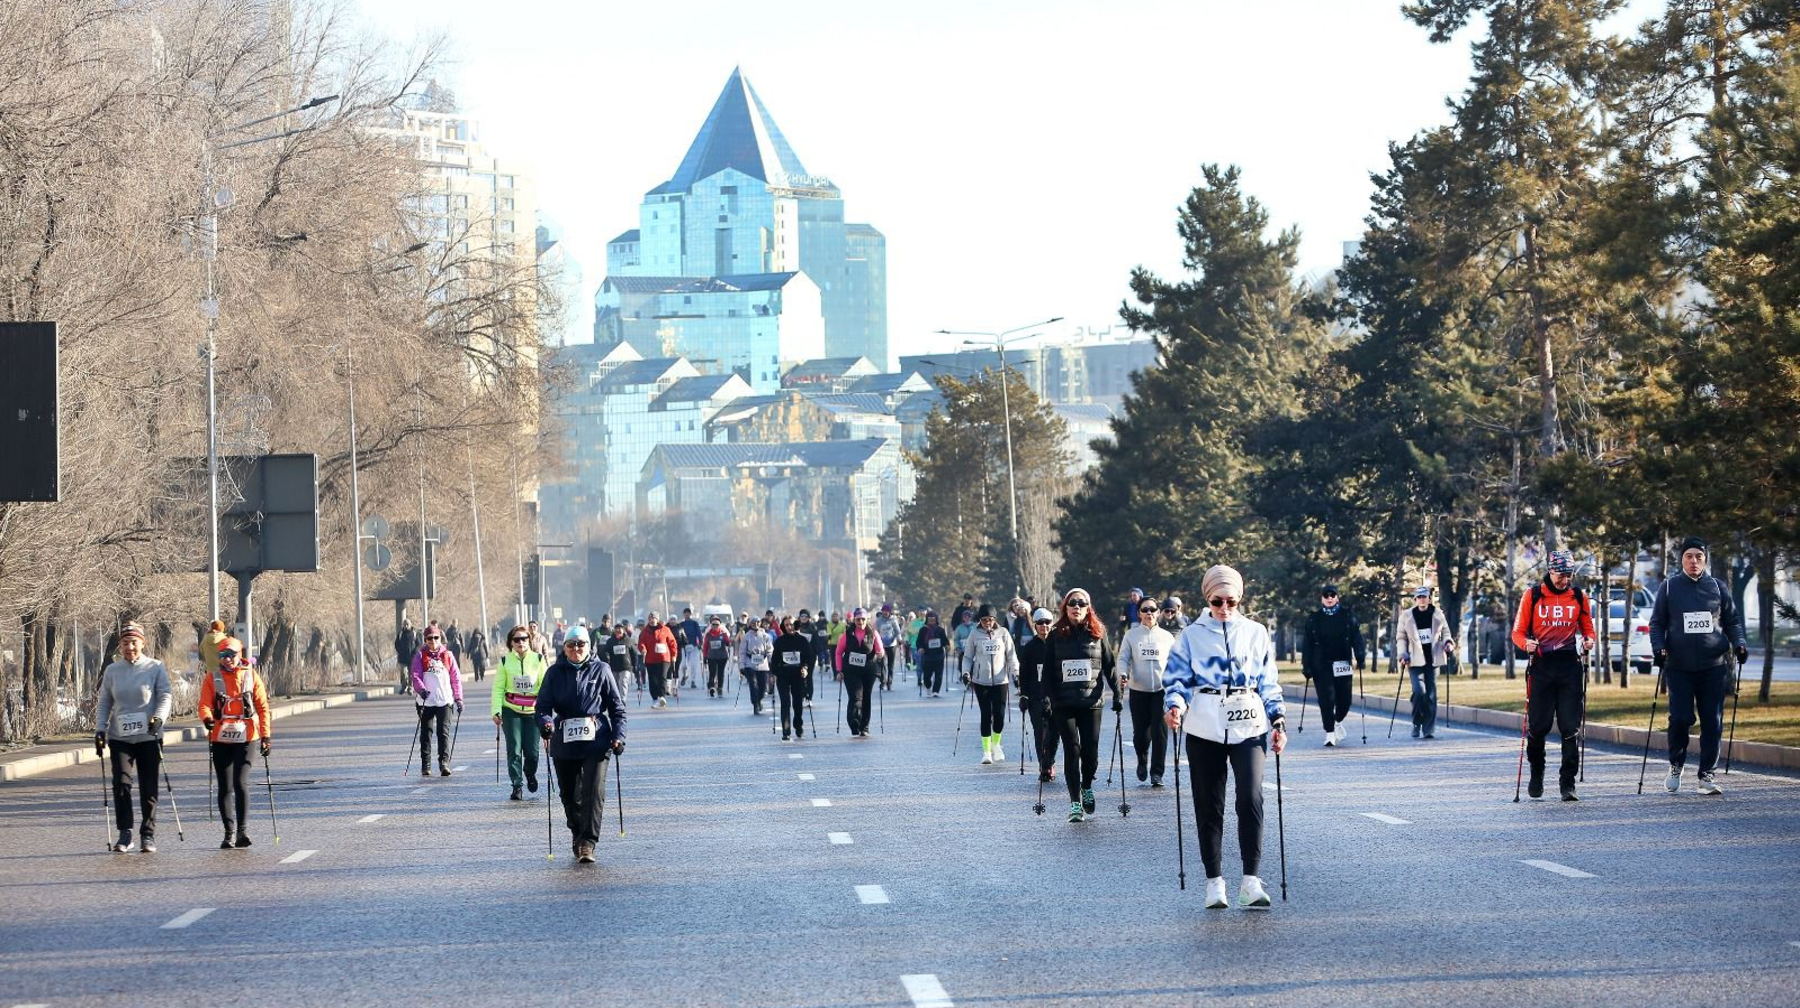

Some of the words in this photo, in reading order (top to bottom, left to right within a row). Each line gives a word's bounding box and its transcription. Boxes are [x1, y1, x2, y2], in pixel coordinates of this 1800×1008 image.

[791, 174, 829, 187] HYUNDAI
[1538, 605, 1576, 618] UBT
[1688, 620, 1710, 629] 2203
[1067, 668, 1088, 676] 2261
[1227, 708, 1257, 721] 2220
[122, 721, 143, 731] 2175
[568, 726, 590, 736] 2179
